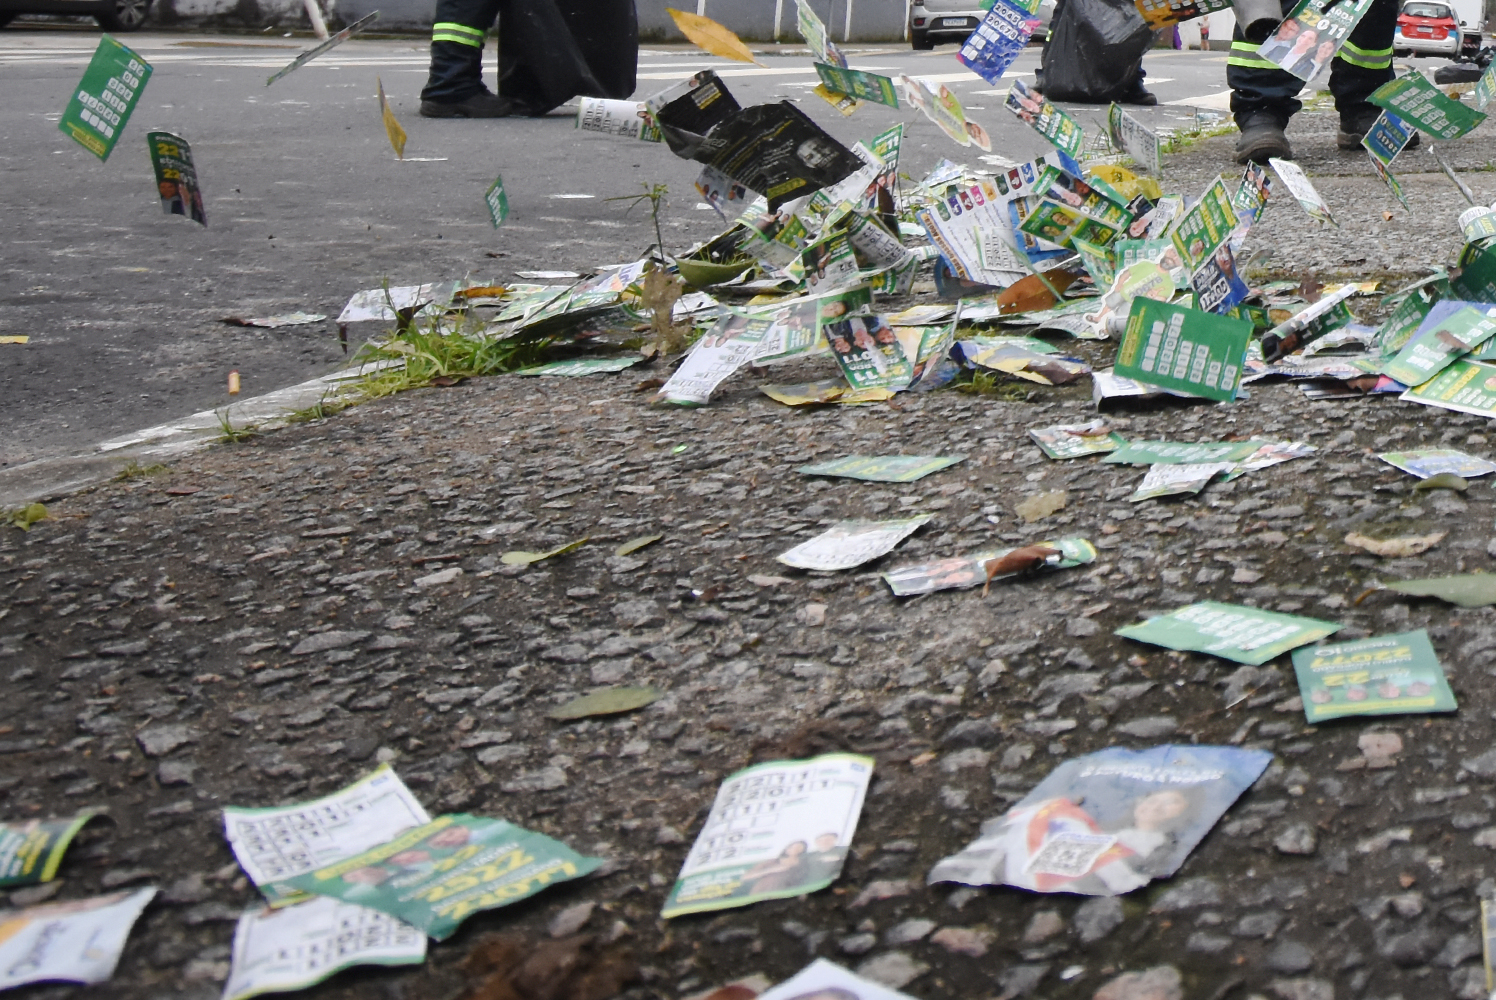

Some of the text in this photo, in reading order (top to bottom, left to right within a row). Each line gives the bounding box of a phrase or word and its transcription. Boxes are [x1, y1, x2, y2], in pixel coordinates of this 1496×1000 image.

[986, 12, 1018, 40] 20678
[1298, 9, 1347, 39] 22011
[1157, 313, 1185, 375] 22077
[1174, 341, 1193, 379] 111
[1189, 345, 1209, 383] 222
[1221, 365, 1237, 391] 22
[1310, 647, 1411, 668] 22077
[1322, 671, 1370, 686] 22
